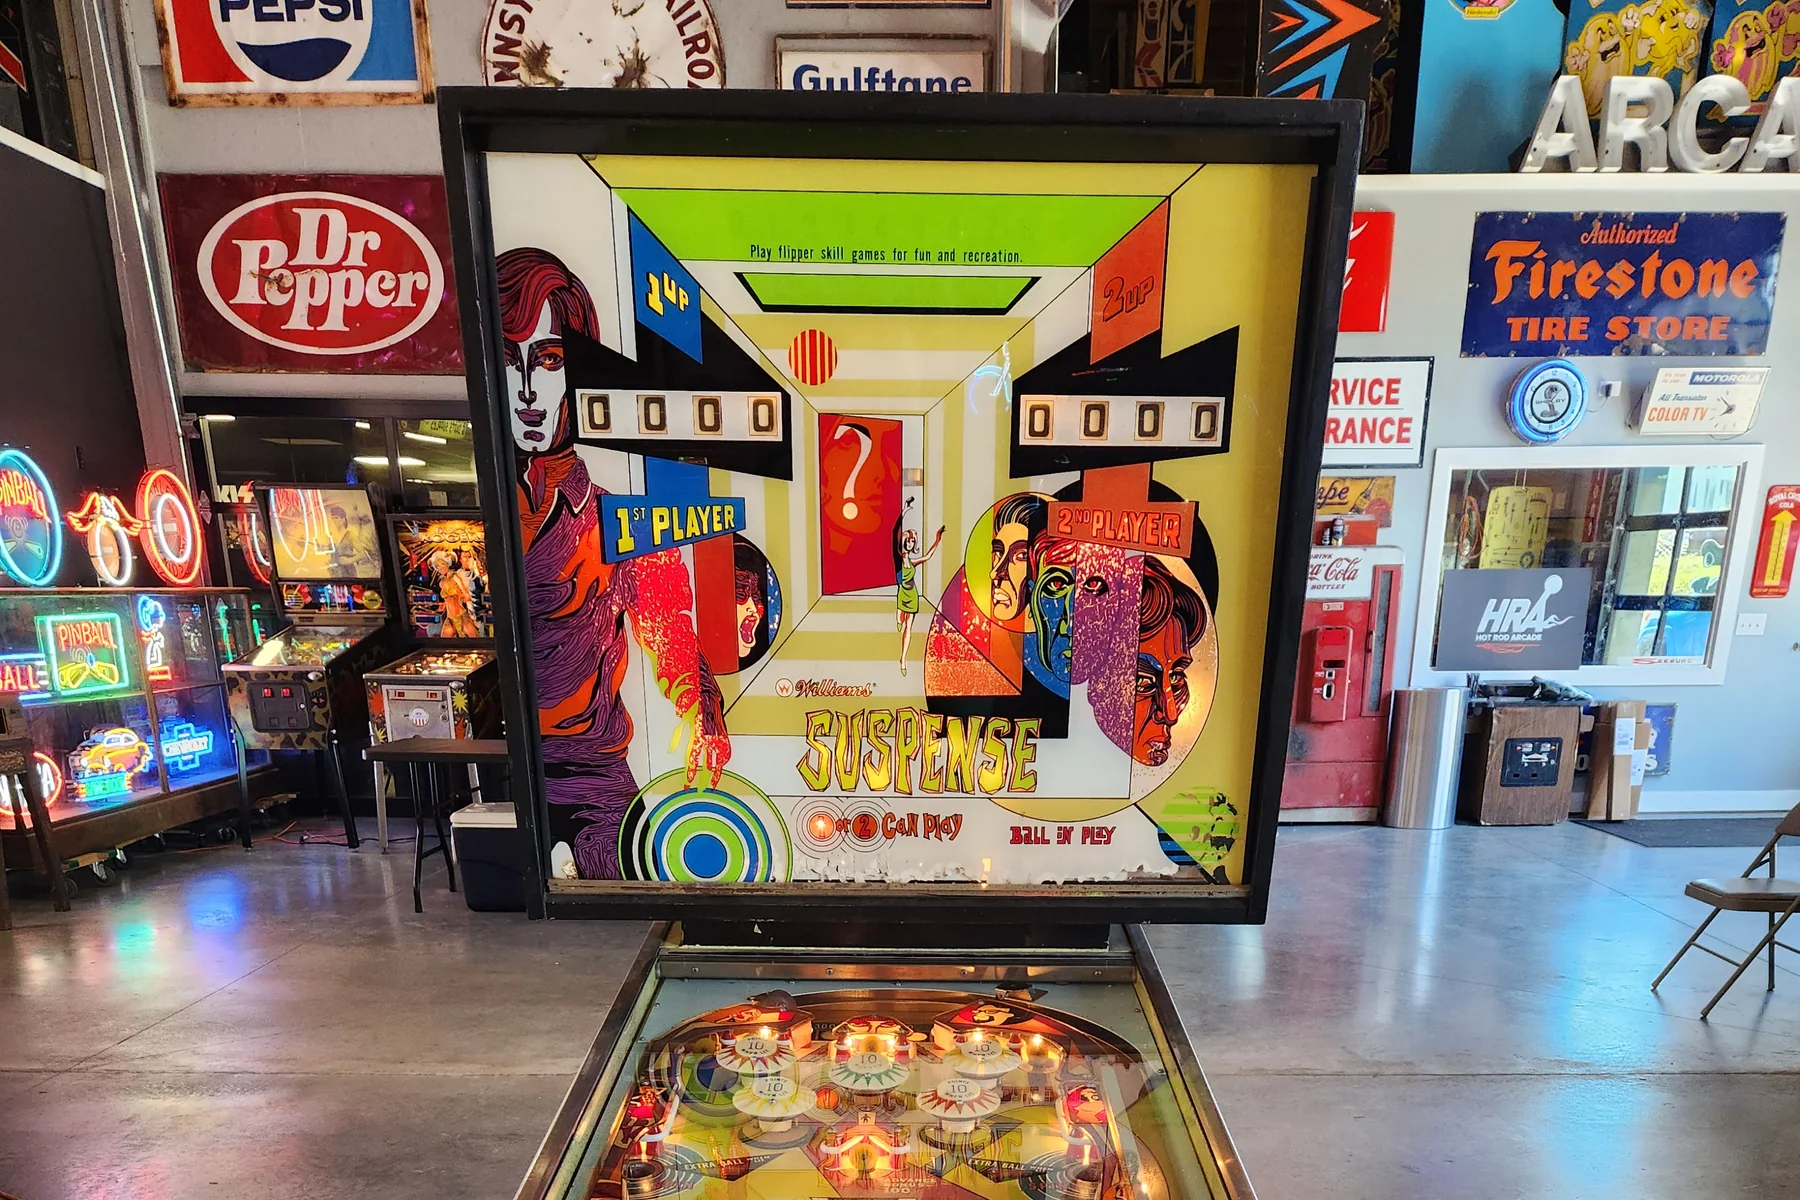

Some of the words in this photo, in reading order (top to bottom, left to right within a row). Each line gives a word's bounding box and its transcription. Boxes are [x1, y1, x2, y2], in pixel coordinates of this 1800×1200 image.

[792, 63, 972, 93] Gulftane
[288, 207, 381, 267] Dr
[1580, 221, 1679, 245] Authorized
[750, 244, 771, 263] Play
[778, 246, 814, 263] flipper
[821, 246, 844, 260] skill
[851, 248, 885, 264] games
[892, 248, 907, 261] for
[914, 248, 931, 261] fun
[937, 248, 955, 262] and
[963, 248, 1023, 264] recreation.
[229, 239, 430, 331] Pepper
[1484, 240, 1760, 305] Firestone
[1507, 316, 1591, 342] TIRE
[1604, 316, 1731, 341] STORE
[1693, 373, 1761, 384] MOTOROLA
[588, 396, 611, 430] 0
[644, 397, 666, 431] 0
[698, 398, 720, 432] 0
[752, 399, 774, 432] 0
[1028, 404, 1050, 438] 0
[1083, 403, 1106, 437] 0
[1138, 403, 1159, 437] 0
[1194, 405, 1217, 439] 0
[1647, 407, 1690, 422] COLOR
[1692, 407, 1709, 421] TV
[0, 469, 52, 524] INBALL
[651, 504, 736, 547] PLAYER
[1091, 509, 1182, 550] PLAYER
[1476, 598, 1547, 633] HRA
[58, 620, 118, 652] PINBALL
[1475, 633, 1492, 641] HOT
[1493, 633, 1510, 641] ROD
[1509, 633, 1543, 641] ARCADE
[794, 679, 874, 698] Williams
[796, 706, 1043, 796] SUSPENSE
[747, 1040, 764, 1050] 10
[860, 1053, 877, 1063] 10
[767, 1082, 784, 1092] 10
[951, 1084, 968, 1094] 10
[684, 1161, 715, 1171] EXTRA
[719, 1158, 745, 1167] BALL
[968, 1158, 998, 1168] EXTRA
[1001, 1162, 1026, 1170] BALL
